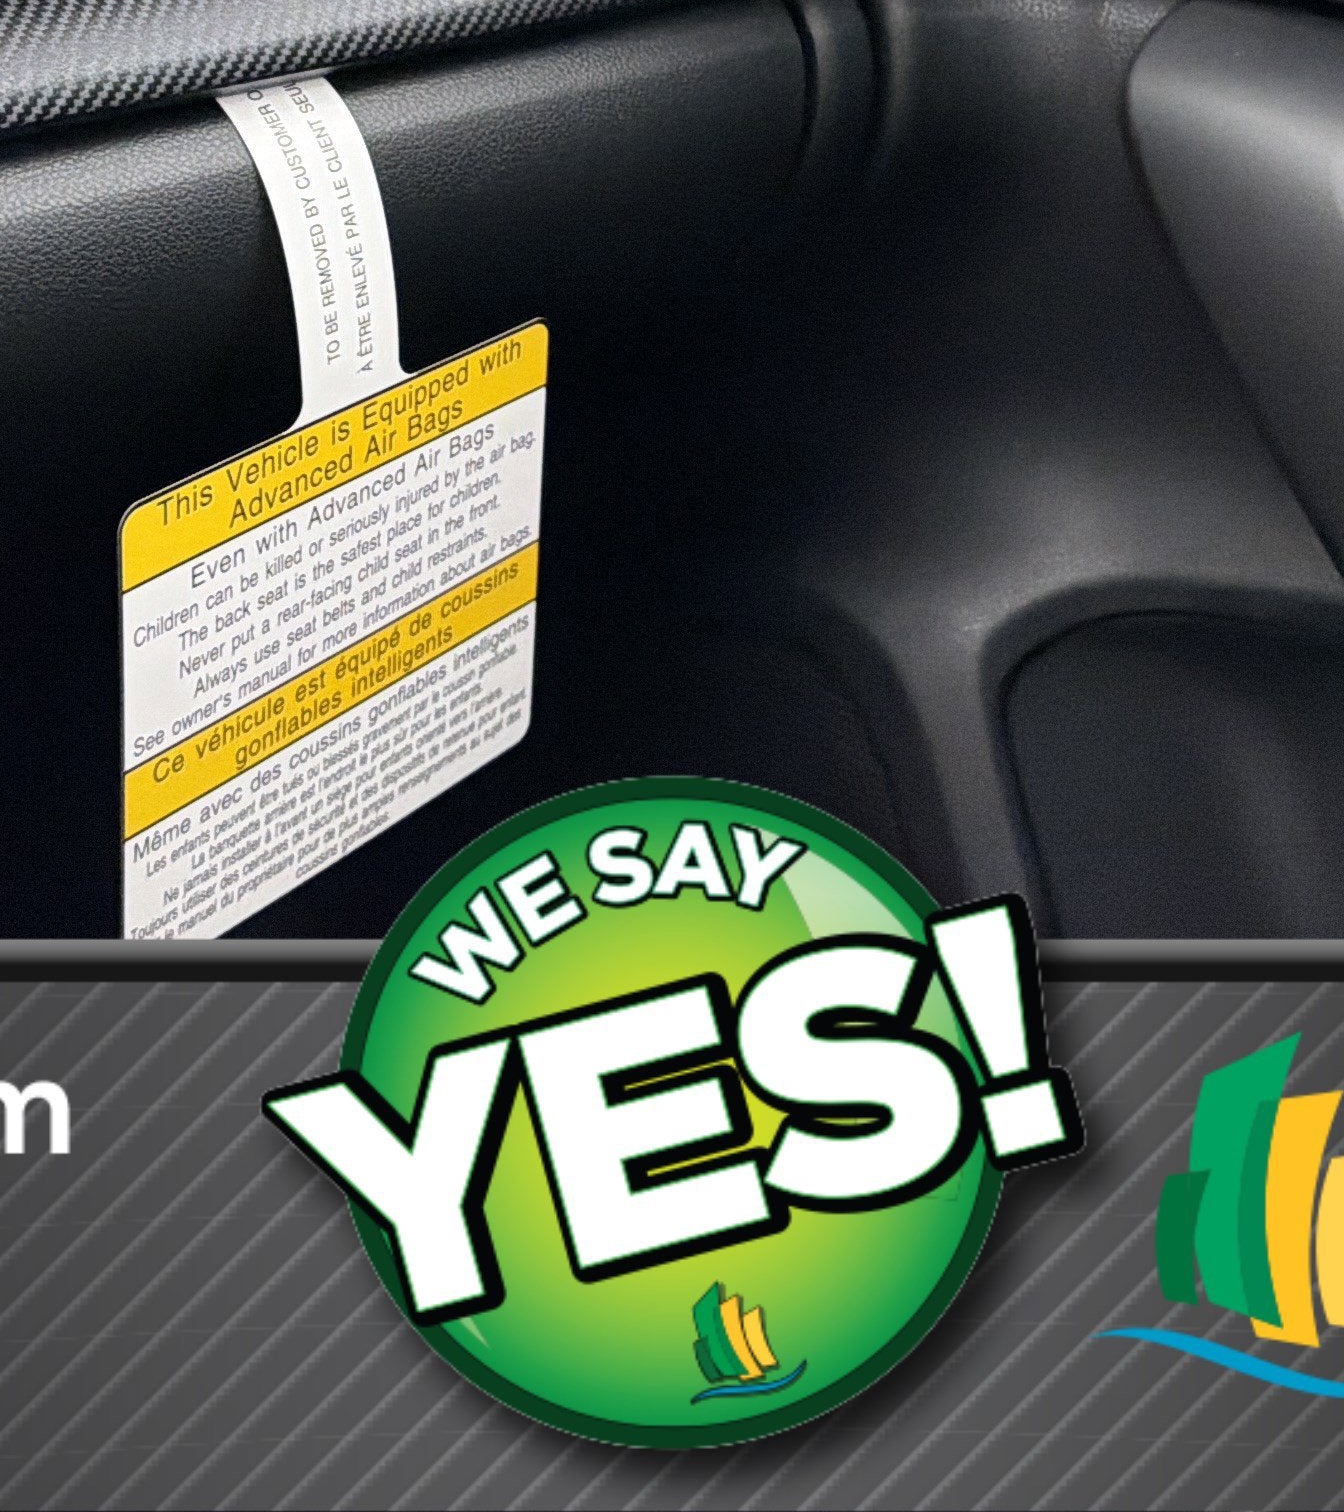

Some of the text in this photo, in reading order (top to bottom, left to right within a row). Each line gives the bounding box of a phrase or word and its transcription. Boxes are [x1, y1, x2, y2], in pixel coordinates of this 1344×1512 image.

[258, 103, 310, 189] CUSTOMER
[301, 196, 319, 218] BY
[307, 119, 342, 172] CLIENT
[333, 177, 351, 199] LE
[309, 223, 336, 307] REMOVED
[341, 204, 360, 239] PAR
[346, 243, 369, 309] ENLEVÉ
[324, 311, 339, 335] BE
[327, 339, 340, 365] TO
[357, 312, 373, 357] ÊTRE
[156, 338, 521, 525] This Vehicle is Equipped with
[229, 399, 462, 527] Advanced Air Bags
[133, 602, 198, 647] Children
[205, 584, 233, 610] can
[239, 571, 258, 592] be
[265, 544, 302, 579] killed
[308, 537, 324, 557] or
[329, 504, 389, 546] seriously
[394, 475, 439, 513] injured
[444, 467, 460, 488] by
[464, 455, 484, 477] the
[489, 443, 506, 464] air
[191, 423, 494, 588] Even with Advanced Air Bags
[178, 625, 208, 650] The
[214, 599, 250, 633] back
[256, 579, 288, 610] seat
[294, 572, 306, 591] is
[312, 558, 334, 581] the
[340, 530, 381, 566] safest
[386, 512, 422, 546] place
[427, 499, 445, 520] for
[179, 641, 225, 679] Never
[231, 623, 255, 655] put
[260, 618, 270, 634] a
[276, 574, 352, 626] rear-facing
[357, 550, 389, 582] child
[394, 533, 422, 563] seat
[426, 528, 439, 544] in
[444, 514, 464, 535] the
[193, 657, 247, 698] Always
[253, 639, 280, 664] use
[286, 615, 316, 646] seat
[322, 598, 355, 627] belts
[360, 576, 387, 605] and
[391, 557, 422, 588] child
[132, 729, 164, 757] See
[171, 692, 231, 735] owner's
[238, 653, 291, 699] manual
[297, 643, 317, 666] for
[321, 622, 357, 652] more
[362, 578, 434, 629] information
[439, 553, 475, 586] about
[479, 543, 496, 563] air
[152, 562, 518, 783] Ce véhicule est équipé de coussins
[235, 690, 341, 769] gonflables
[351, 625, 452, 697] intelligents
[132, 817, 190, 863] Même
[199, 786, 242, 824] avec
[249, 763, 281, 794] des
[288, 715, 361, 769] coussins
[367, 664, 446, 727] gonflables
